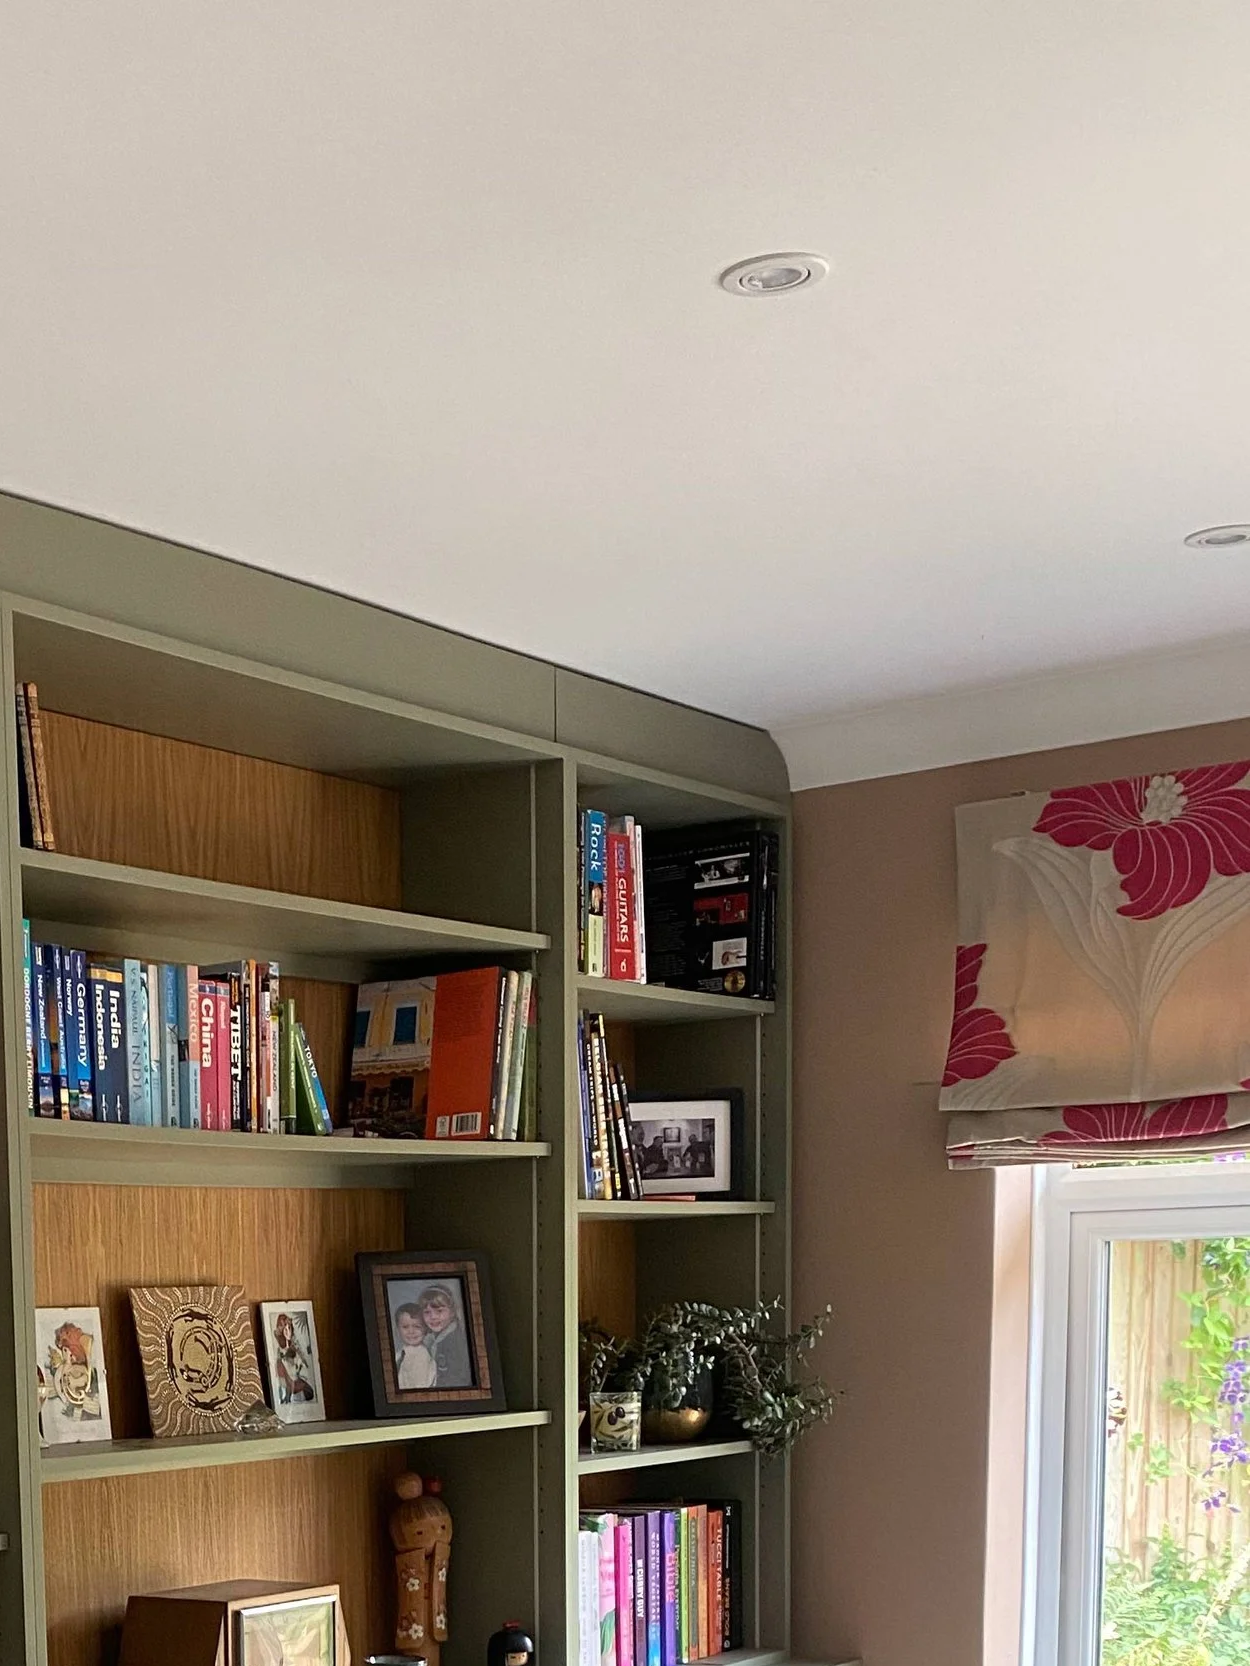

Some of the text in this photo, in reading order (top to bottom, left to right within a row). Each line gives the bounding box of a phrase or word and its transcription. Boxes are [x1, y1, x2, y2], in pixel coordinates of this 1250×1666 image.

[590, 823, 601, 871] Rock
[618, 878, 629, 942] GUITARS
[39, 999, 47, 1039] Zealand
[65, 978, 73, 1016] Norway
[76, 983, 88, 1067] Germany
[109, 990, 121, 1049] India
[189, 983, 198, 1043] Mexico
[95, 984, 107, 1070] Indonesia
[201, 998, 214, 1068] China
[230, 1005, 241, 1081] TIBET
[131, 1045, 142, 1103] INDIA
[304, 1045, 318, 1078] TOKYO
[667, 1552, 675, 1603] Bible
